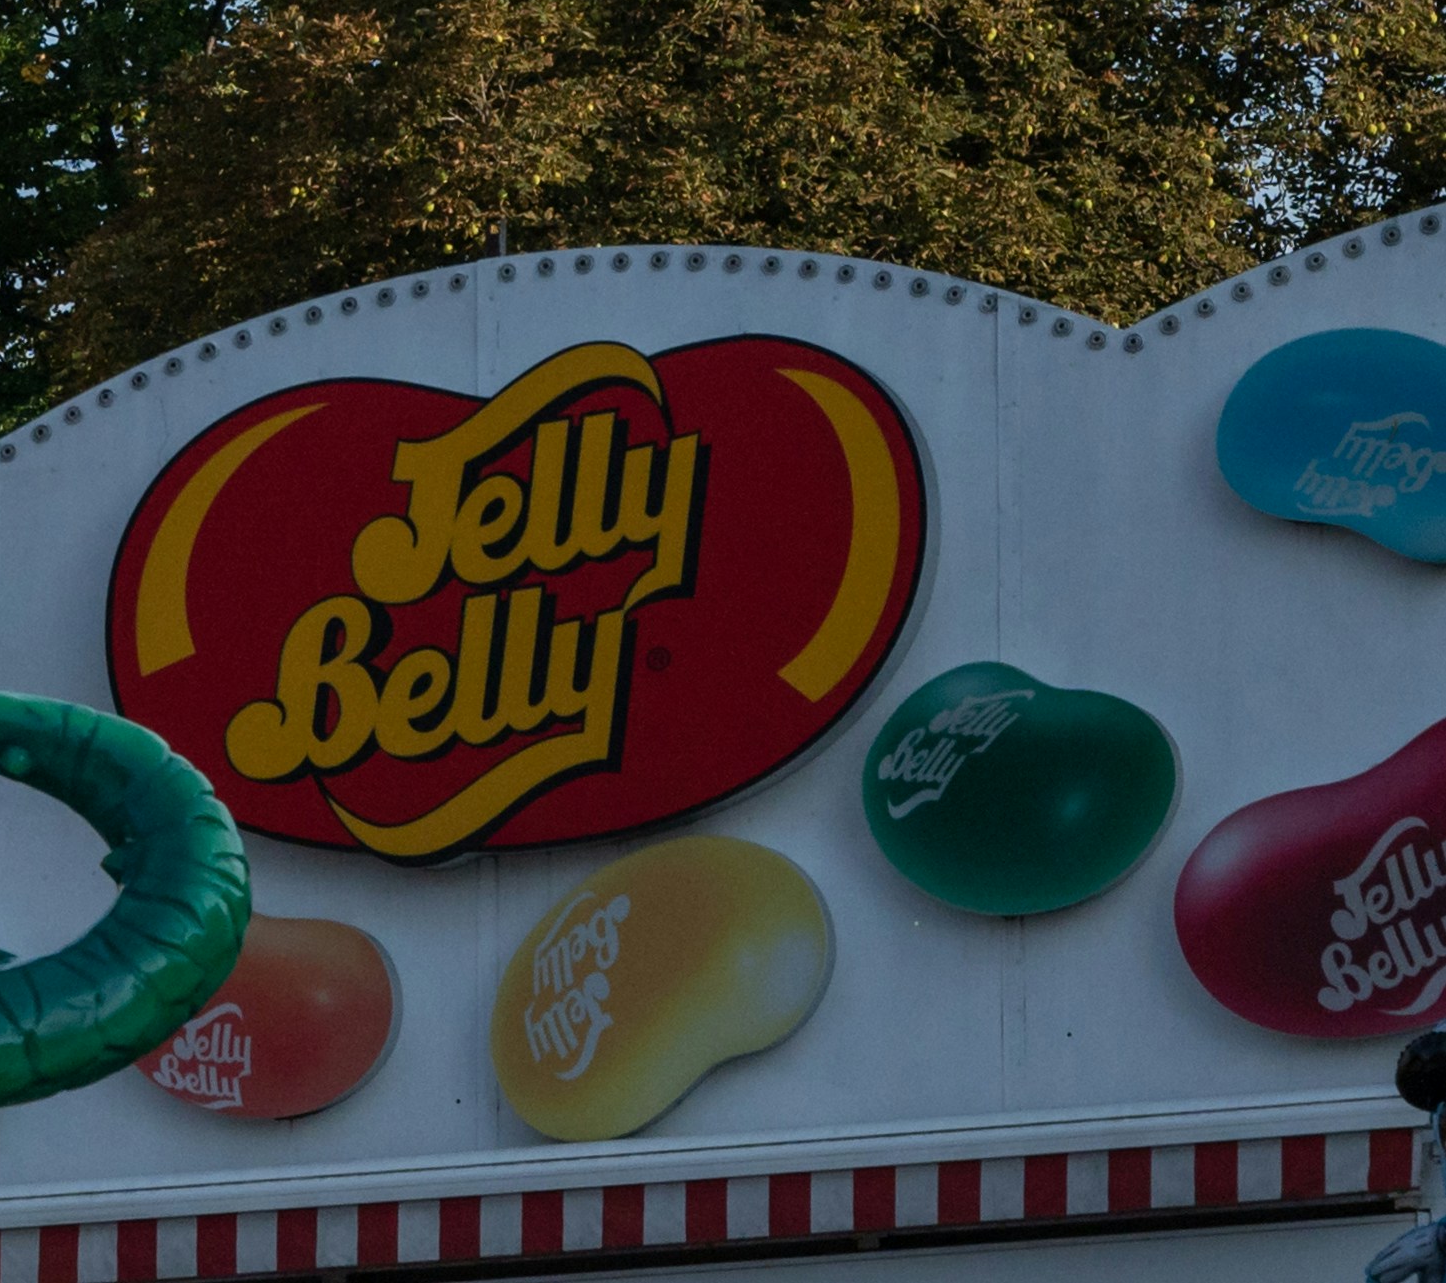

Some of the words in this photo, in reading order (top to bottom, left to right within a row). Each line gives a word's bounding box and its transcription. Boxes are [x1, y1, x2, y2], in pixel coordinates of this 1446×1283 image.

[351, 341, 705, 607] Jelly
[224, 585, 631, 858] Belly
[928, 688, 1036, 754] Jelly
[878, 727, 967, 820] Belly
[533, 891, 631, 996] Belly
[173, 1002, 252, 1077] Jelly
[524, 972, 614, 1080] Jelly
[152, 1053, 243, 1110] Belly
